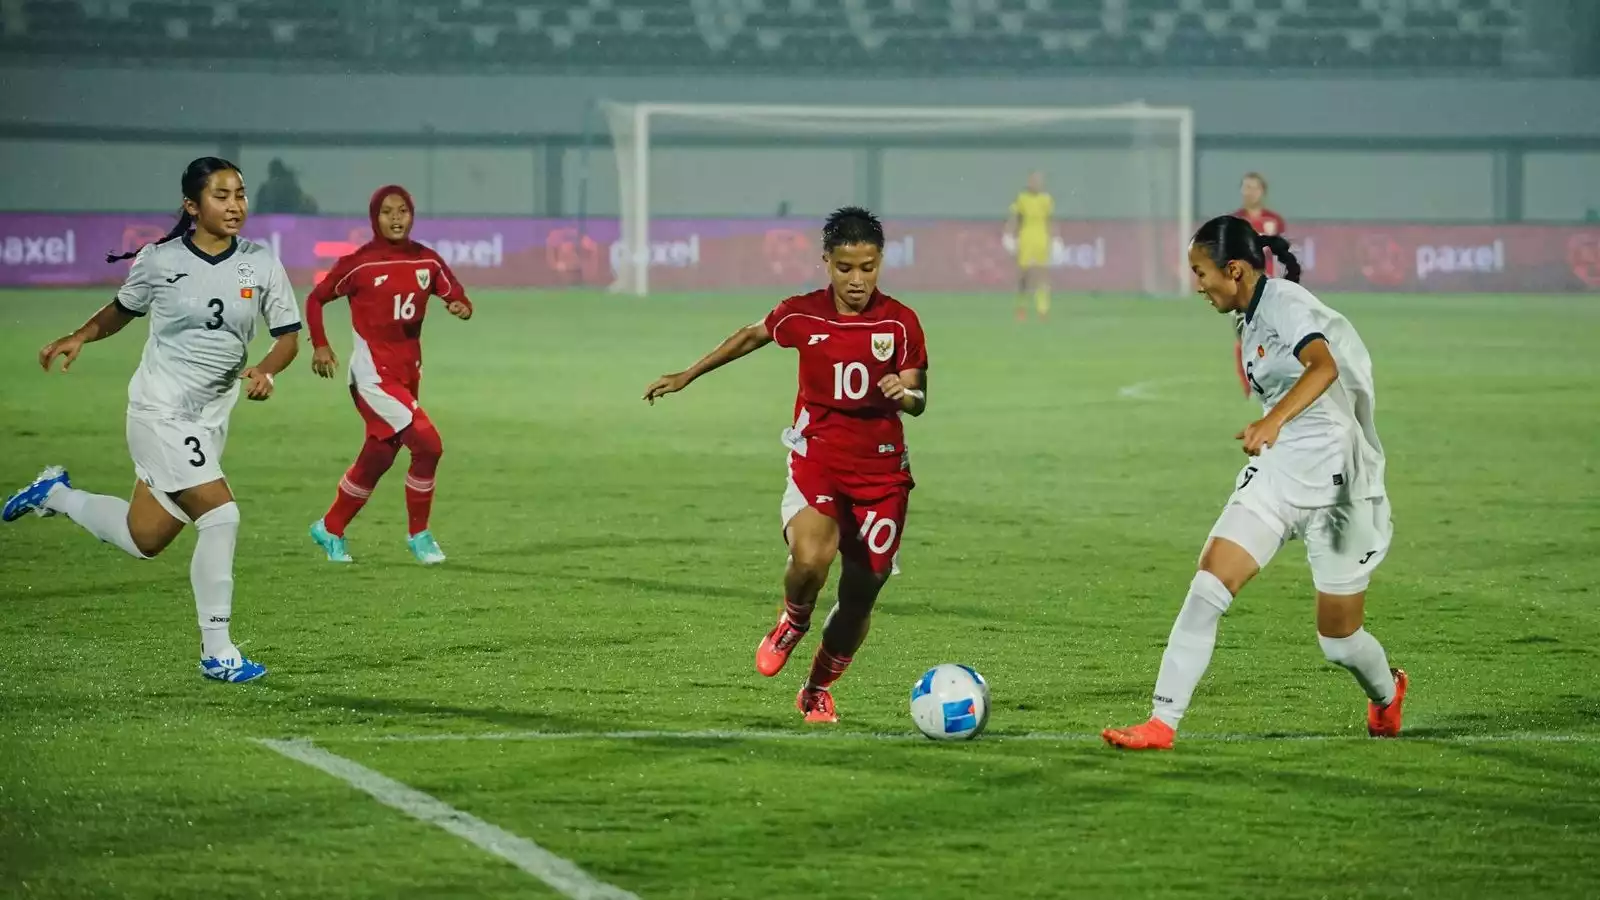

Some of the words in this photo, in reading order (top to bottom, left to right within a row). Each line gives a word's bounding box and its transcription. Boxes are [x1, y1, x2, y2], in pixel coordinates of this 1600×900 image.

[0, 229, 76, 266] axel
[417, 233, 503, 268] axel
[1416, 239, 1504, 279] paxel
[206, 298, 225, 330] 3
[393, 292, 416, 320] 16
[833, 361, 870, 400] 10
[184, 436, 206, 467] 3
[857, 510, 897, 554] 10
